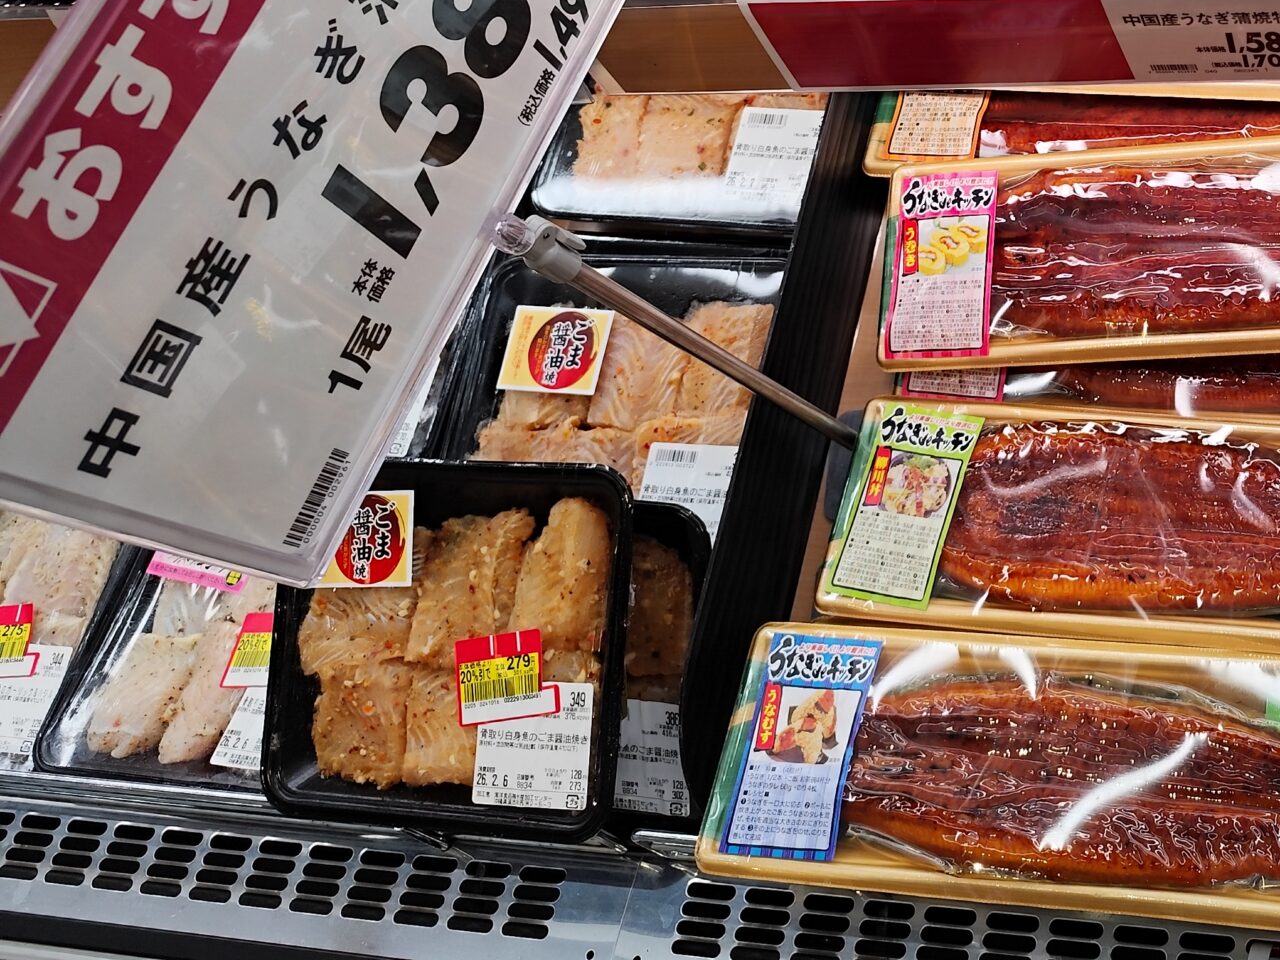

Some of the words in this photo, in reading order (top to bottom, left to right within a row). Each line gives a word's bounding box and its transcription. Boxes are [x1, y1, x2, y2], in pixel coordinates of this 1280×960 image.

[327, 314, 394, 395] 1尾
[566, 319, 595, 368] ごま
[373, 501, 396, 559] ごま
[760, 690, 777, 745] うなむす
